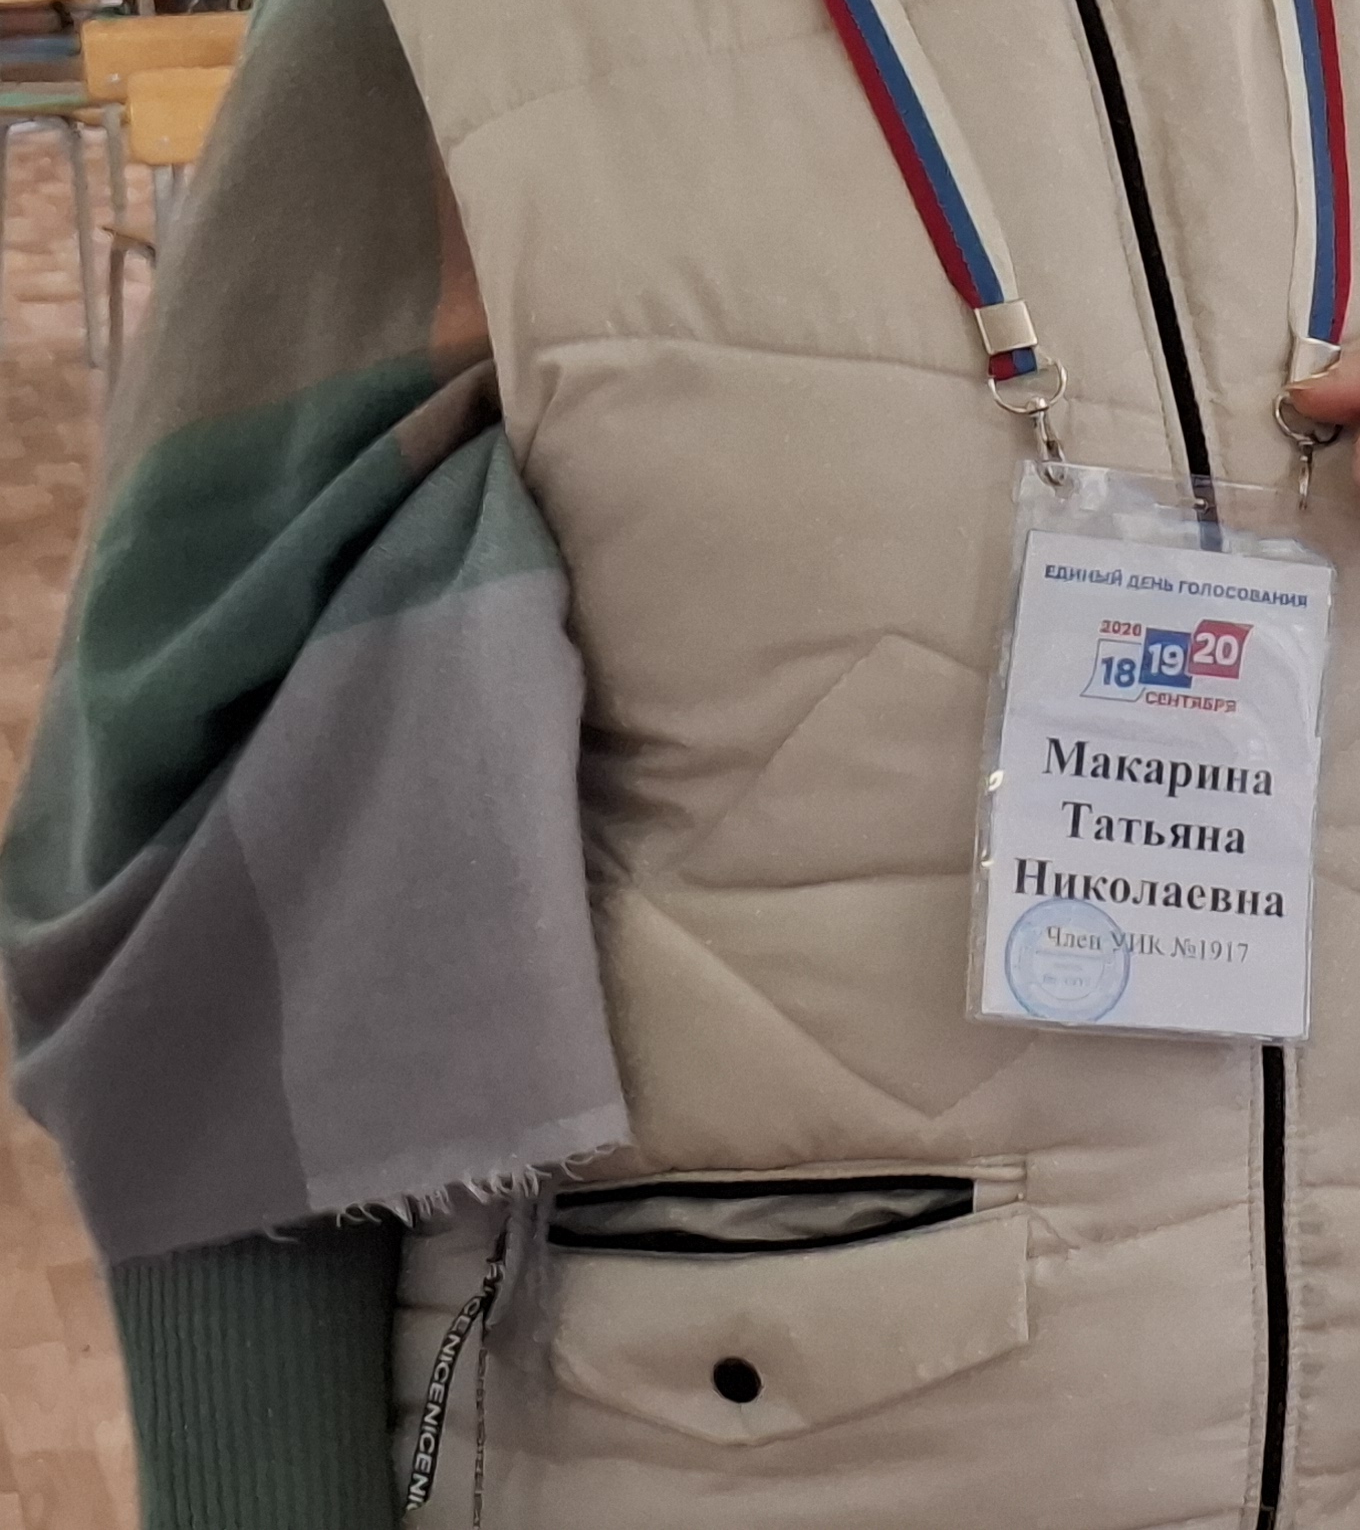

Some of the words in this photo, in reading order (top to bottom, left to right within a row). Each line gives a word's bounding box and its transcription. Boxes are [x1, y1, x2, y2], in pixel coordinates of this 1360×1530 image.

[1044, 564, 1122, 587] ЕДИНЫЙ
[1127, 574, 1173, 592] ДЕНЬ
[1178, 580, 1308, 608] ГОЛОСОВАНИЯ
[1100, 620, 1142, 637] 2020
[1101, 656, 1136, 688] 18
[1147, 643, 1184, 676] 19
[1193, 632, 1239, 666] 20
[1145, 691, 1237, 713] СЕНТЯБРЯ
[1042, 737, 1272, 798] Макарина
[1061, 800, 1245, 854] Татьяна
[1014, 857, 1285, 918] Николаевна
[1047, 925, 1103, 950] Член
[1111, 930, 1165, 956] УИК
